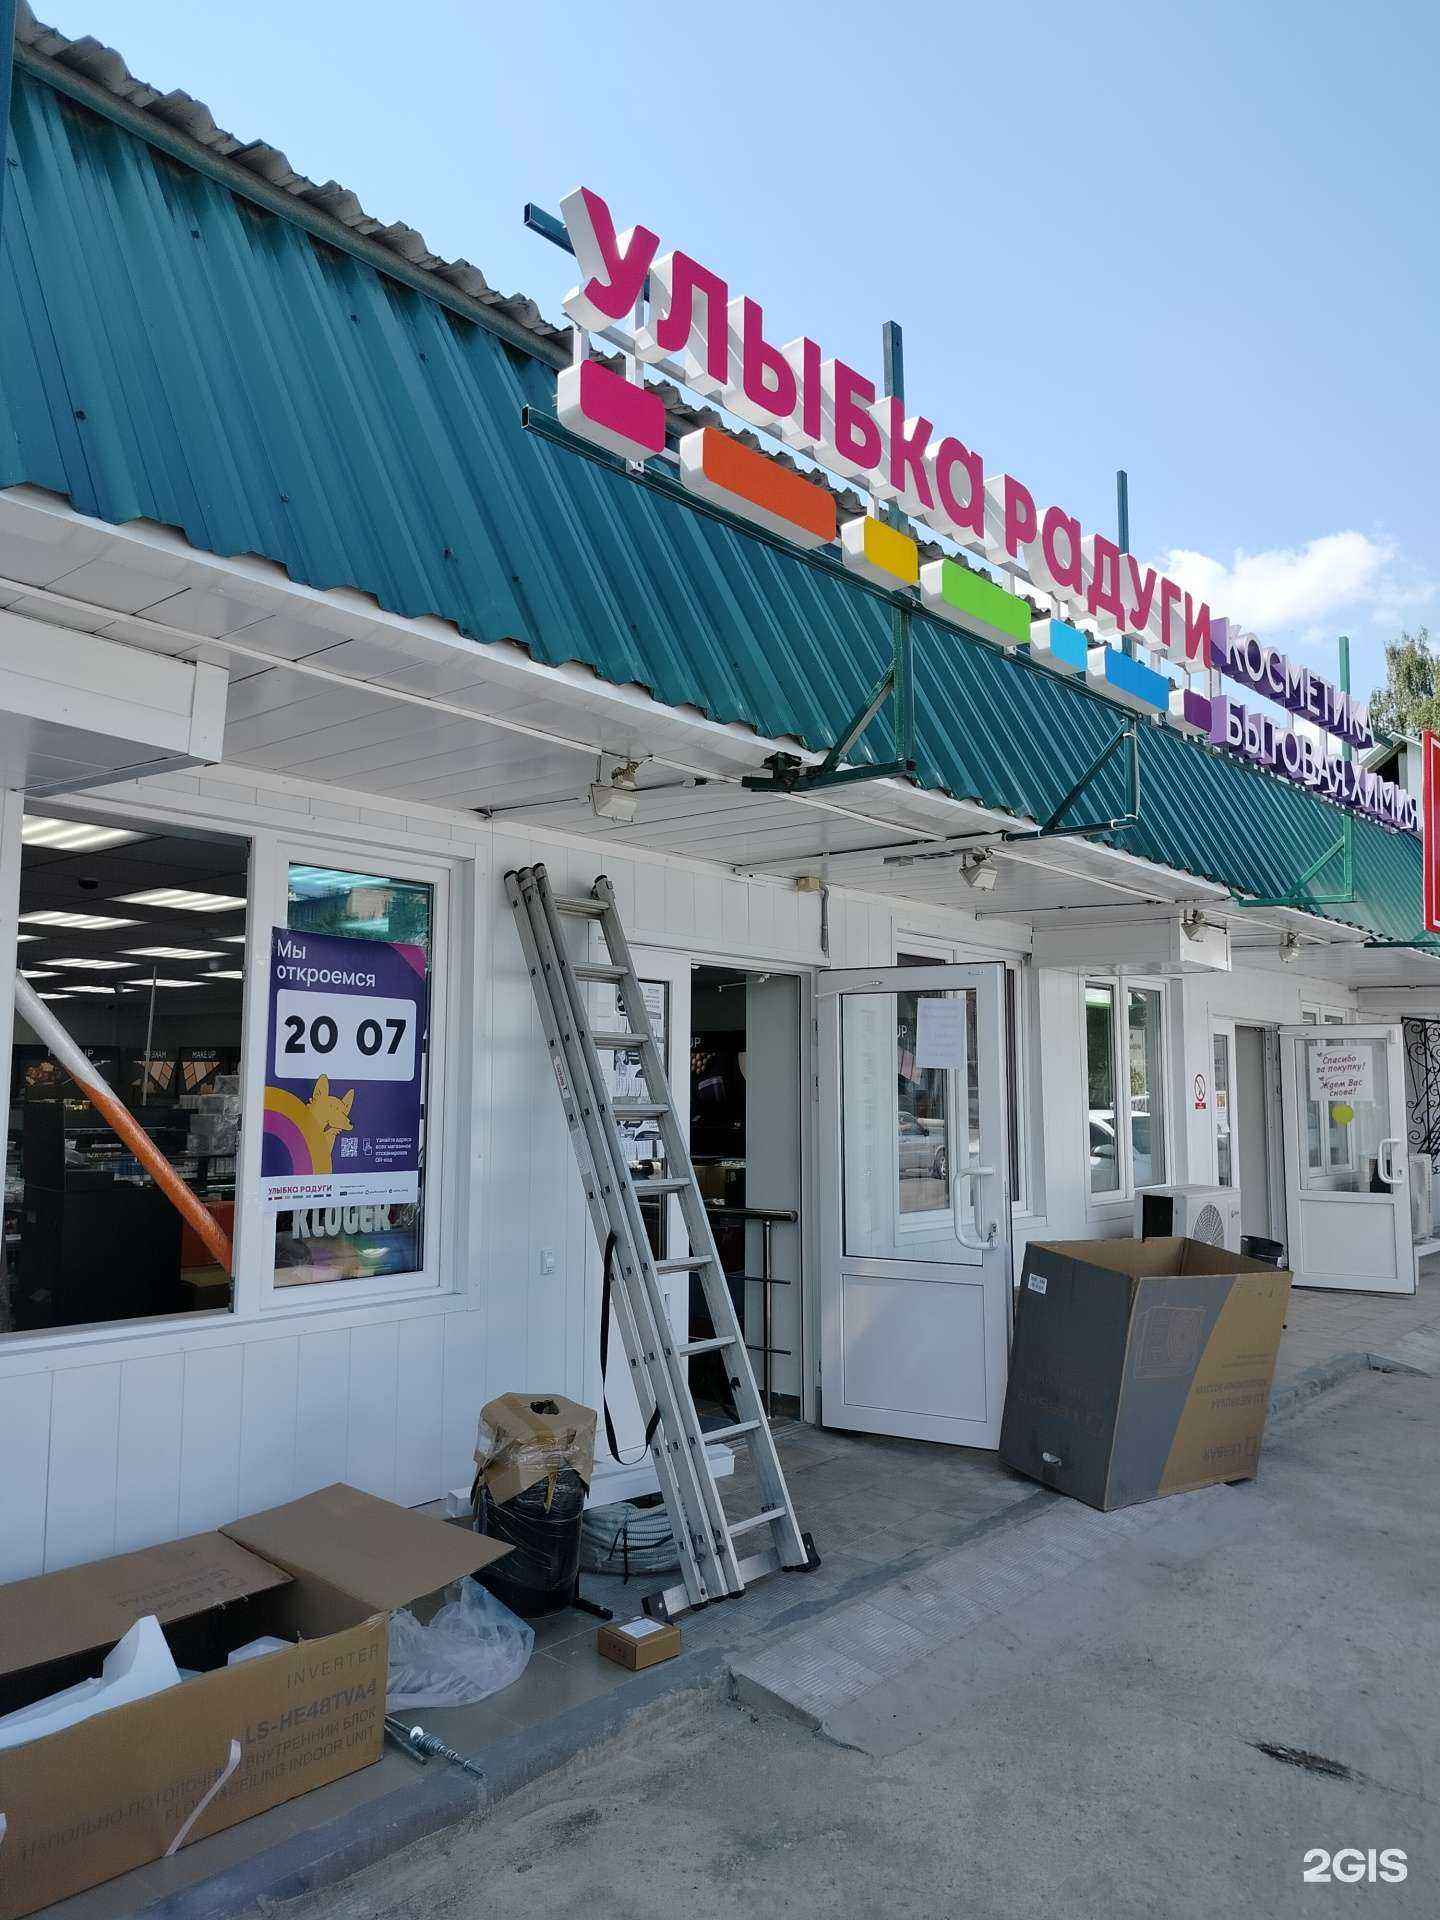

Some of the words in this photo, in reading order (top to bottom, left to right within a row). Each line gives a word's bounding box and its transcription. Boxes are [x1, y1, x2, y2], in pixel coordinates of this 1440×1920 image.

[1221, 616, 1376, 749] КОСМЕТИКА
[1225, 697, 1350, 796] БЫТОВАЯ
[1349, 761, 1421, 832] ХИМИЯ
[277, 939, 306, 960] Мы
[276, 965, 376, 987] откроемся
[284, 1015, 338, 1054] 20
[356, 1018, 407, 1056] 07
[1322, 1055, 1357, 1065] Спасибо
[287, 1644, 378, 1689] INVERTER
[343, 1707, 376, 1735] БЛОК
[296, 1739, 343, 1774] INDOOR
[346, 1726, 375, 1749] UNIT
